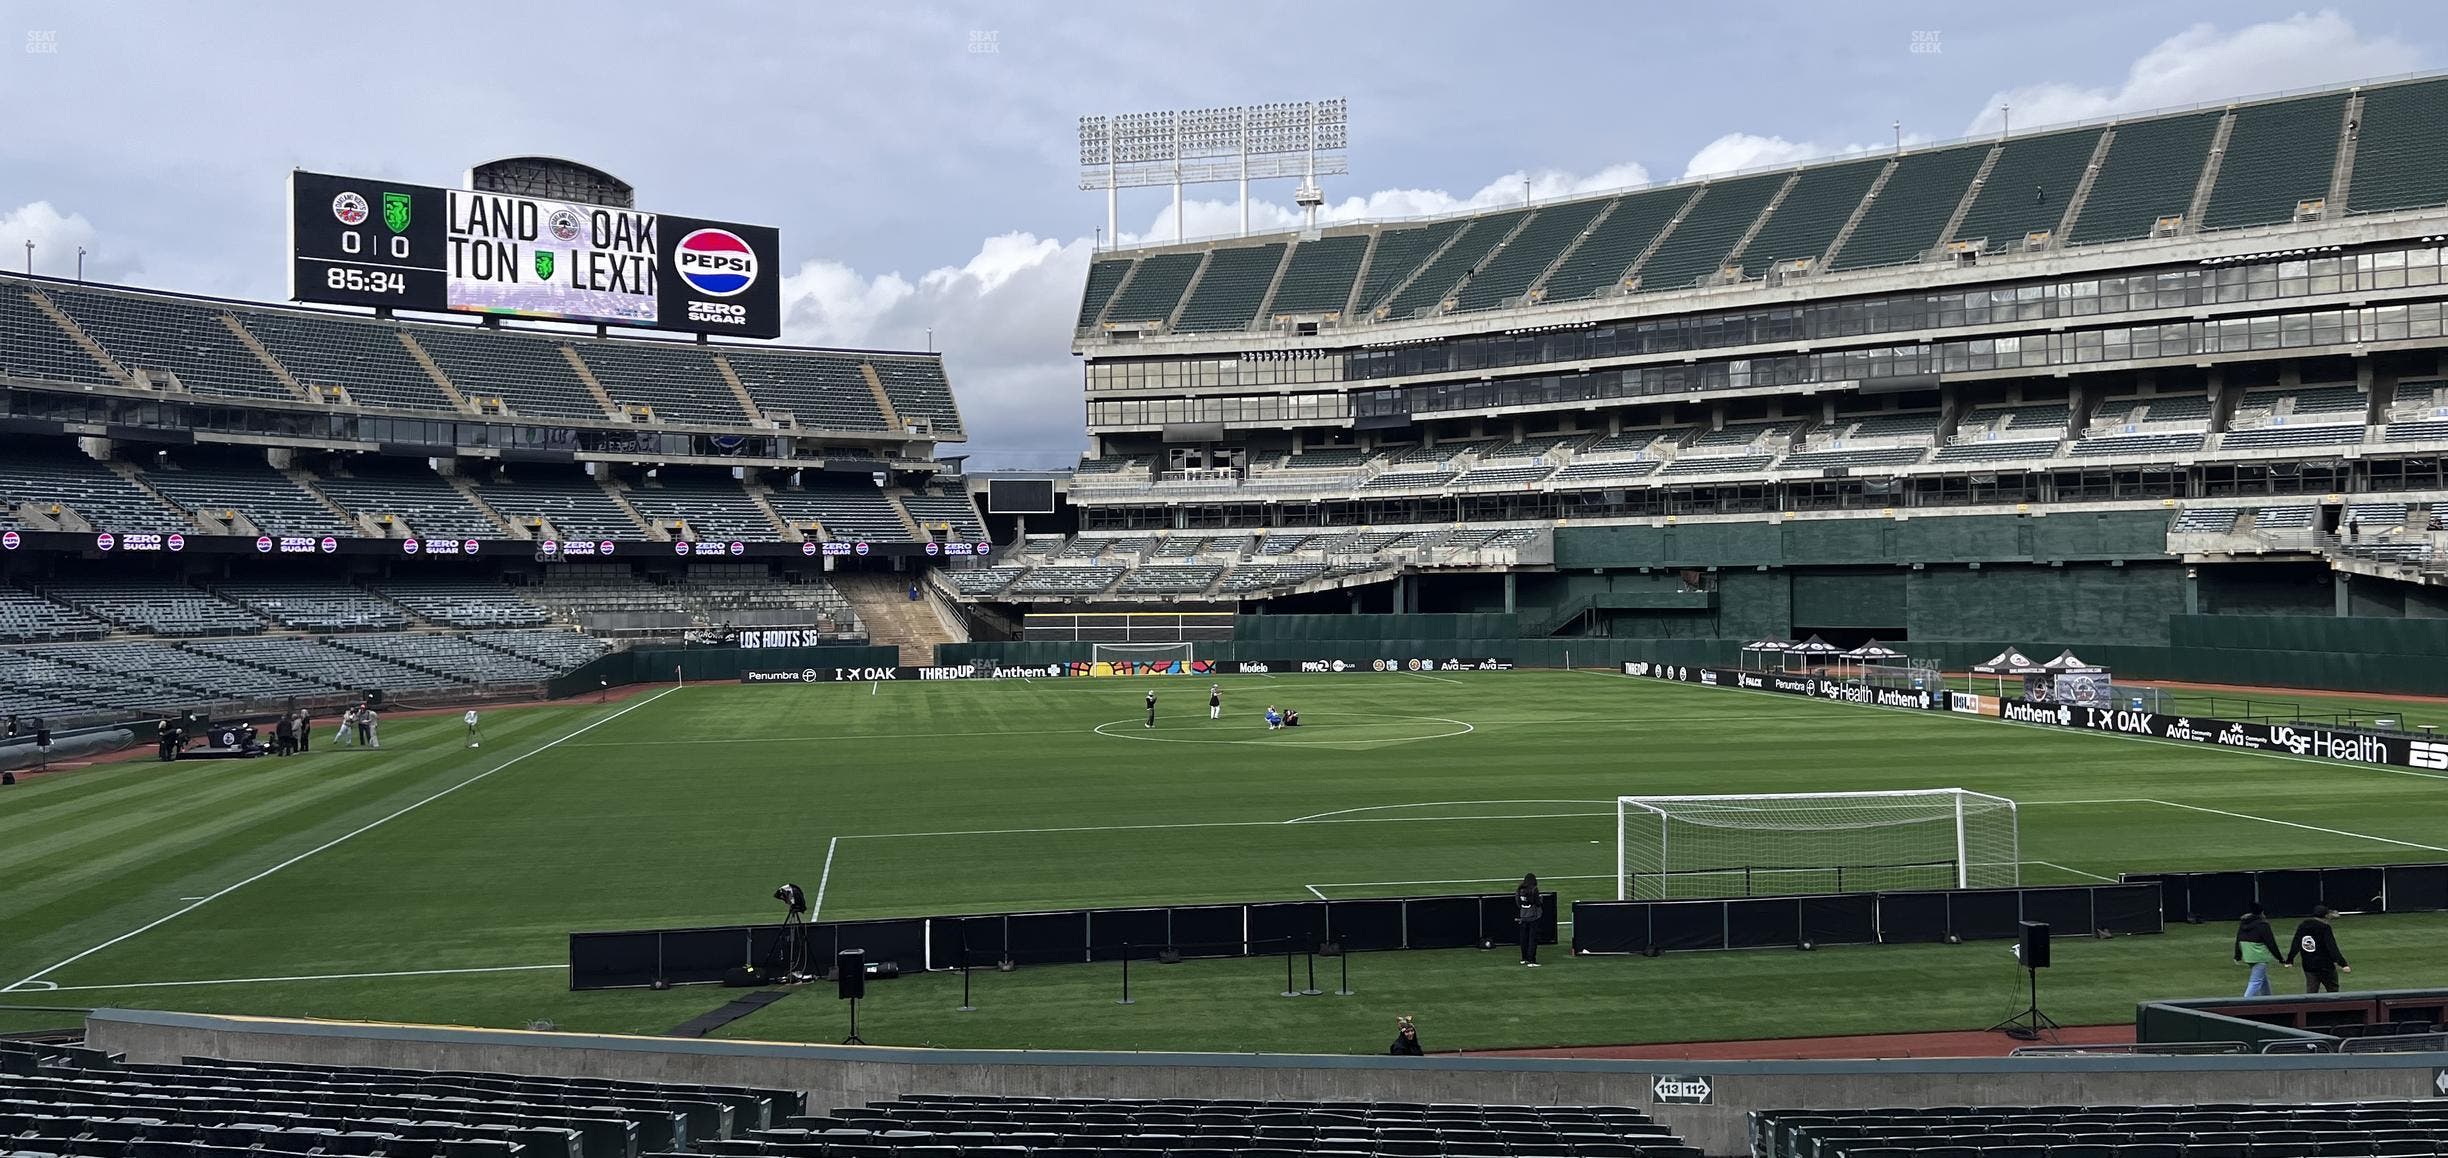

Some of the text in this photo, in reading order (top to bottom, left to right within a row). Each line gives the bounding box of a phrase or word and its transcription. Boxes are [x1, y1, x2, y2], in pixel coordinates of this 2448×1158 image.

[450, 193, 655, 254] LAND OAK
[342, 231, 409, 258] 0 0
[449, 237, 518, 283] TON
[682, 252, 751, 272] PEPSI
[327, 267, 406, 294] 85:34
[688, 301, 746, 316] ZERO
[688, 312, 746, 325] SUGAR
[123, 535, 161, 543] ZERO
[740, 631, 760, 649] LOS
[762, 630, 800, 648] ROOTS
[836, 667, 896, 680] I OAK
[919, 665, 975, 680] THREDUP
[992, 666, 1047, 678] Anthem
[1240, 662, 1268, 673] Modelo
[1441, 662, 1459, 671] Ava
[1479, 662, 1496, 670] Ava
[1625, 662, 1649, 676] THREDUP
[749, 671, 799, 680] Penumbra
[1775, 678, 1804, 692] Penumbra
[1820, 680, 1873, 704] UCSF Health
[1878, 689, 1919, 708] Anthem
[2004, 702, 2057, 724] Anthem
[2087, 708, 2153, 734] I OAK
[2166, 724, 2190, 740] Ava
[2218, 730, 2244, 746] Ava
[2245, 736, 2268, 744] Community
[2270, 726, 2387, 764] UCSF Health
[1659, 1085, 1679, 1094] 113
[1686, 1085, 1706, 1095] 112
